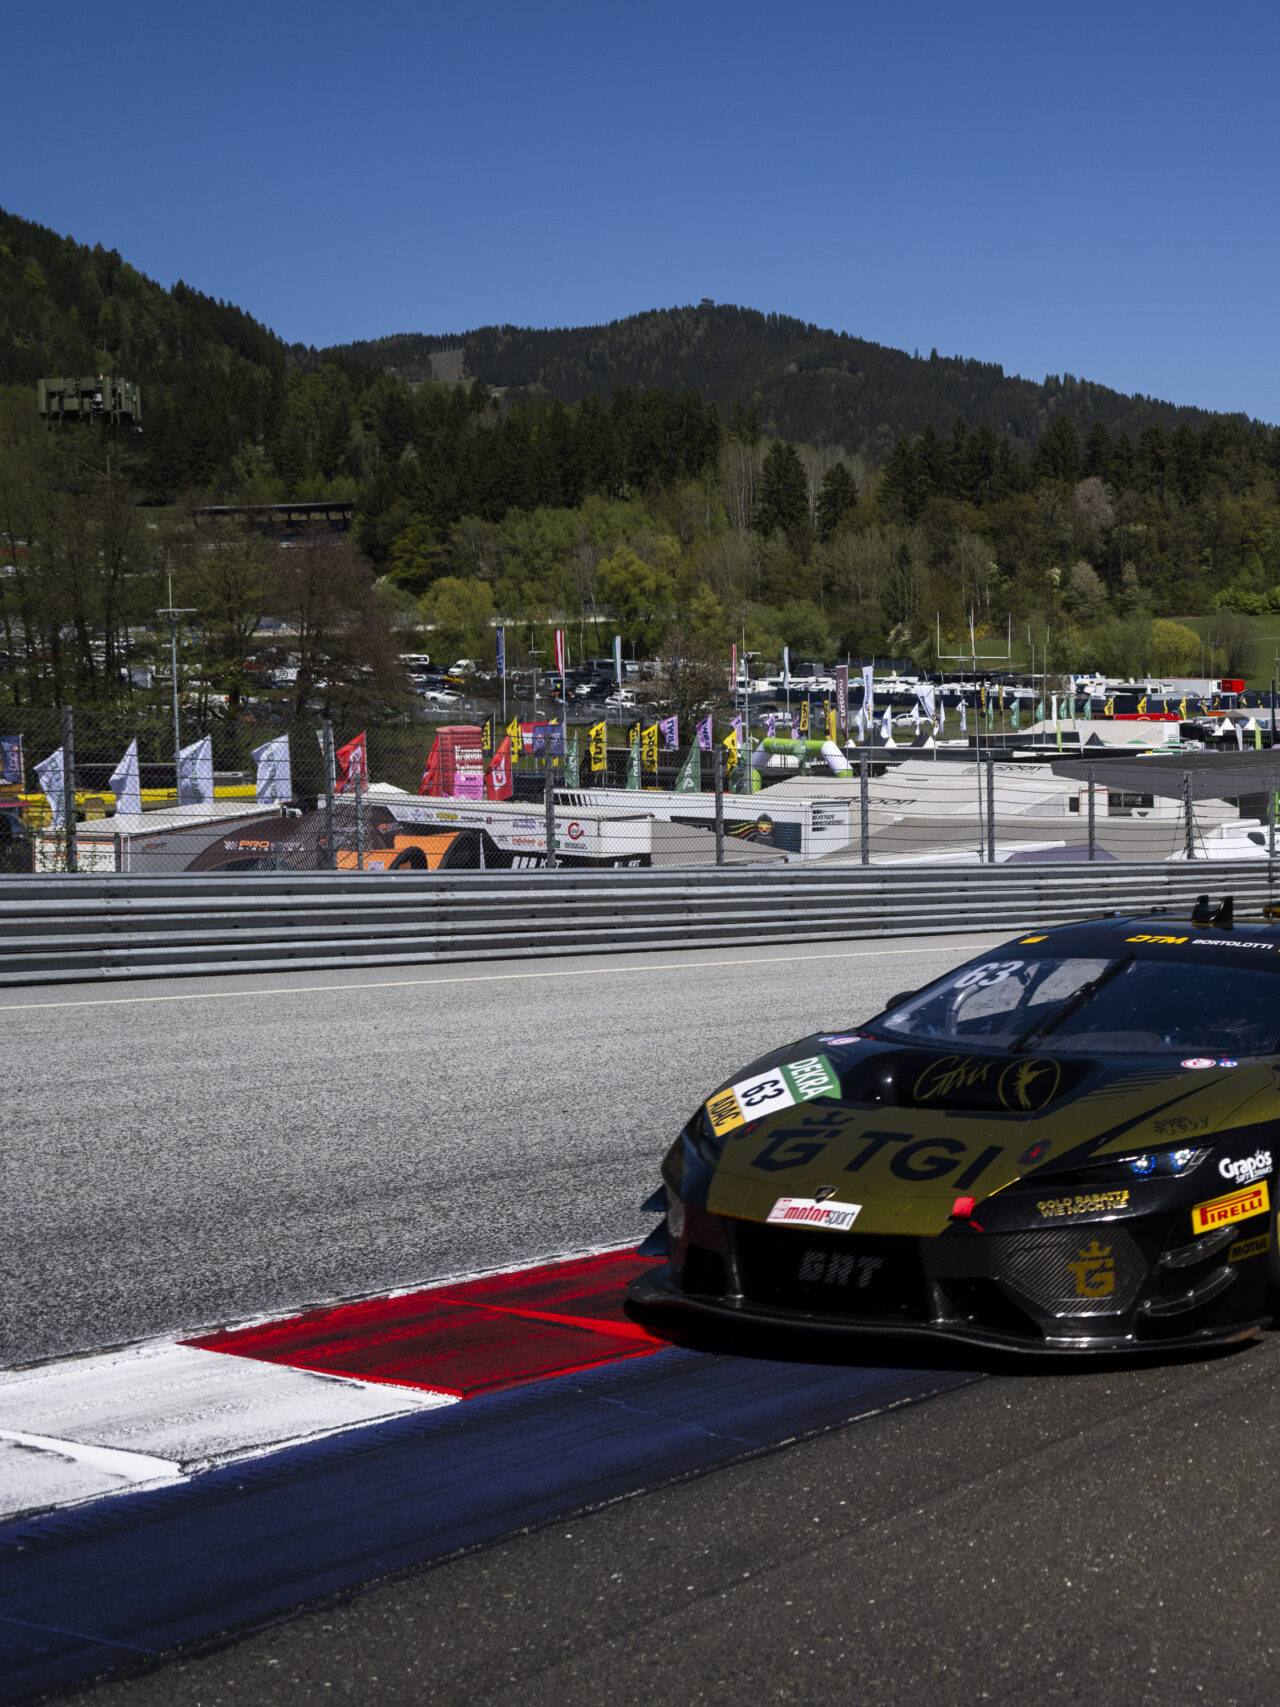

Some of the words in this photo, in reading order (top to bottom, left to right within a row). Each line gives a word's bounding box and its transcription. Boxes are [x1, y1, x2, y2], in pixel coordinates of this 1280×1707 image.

[1125, 935, 1189, 944] DTM
[1192, 939, 1273, 950] BORTOLOTTI
[954, 960, 1025, 989] 63
[787, 1057, 834, 1100] DEKRA
[741, 1079, 785, 1107] 63
[709, 1095, 740, 1127] ADAC
[843, 1130, 1005, 1191] TGI
[1037, 1196, 1072, 1209] GOLD
[1075, 1190, 1130, 1204] RABATTE
[1041, 1206, 1065, 1218] WIE
[1067, 1202, 1104, 1215] NOCH
[1109, 1199, 1129, 1210] NIE
[1200, 1189, 1263, 1226] PIRELLI
[783, 1205, 855, 1227] motorsport
[1232, 1237, 1267, 1257] MOTUL
